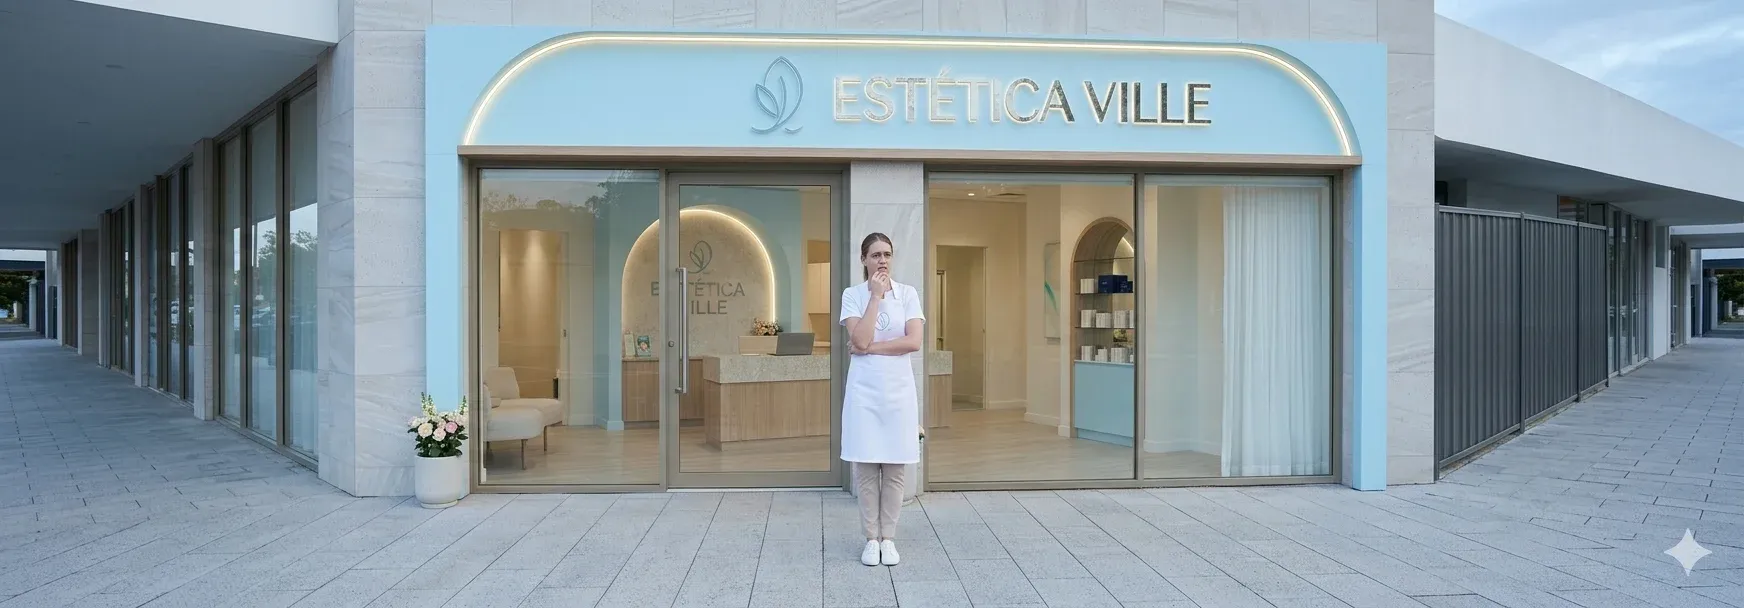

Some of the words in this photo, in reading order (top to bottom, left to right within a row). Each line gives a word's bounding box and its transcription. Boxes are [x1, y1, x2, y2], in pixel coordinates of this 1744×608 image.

[834, 67, 1075, 123] ESTÉTICA
[1083, 80, 1212, 124] VILLE
[690, 300, 728, 315] ILLE
